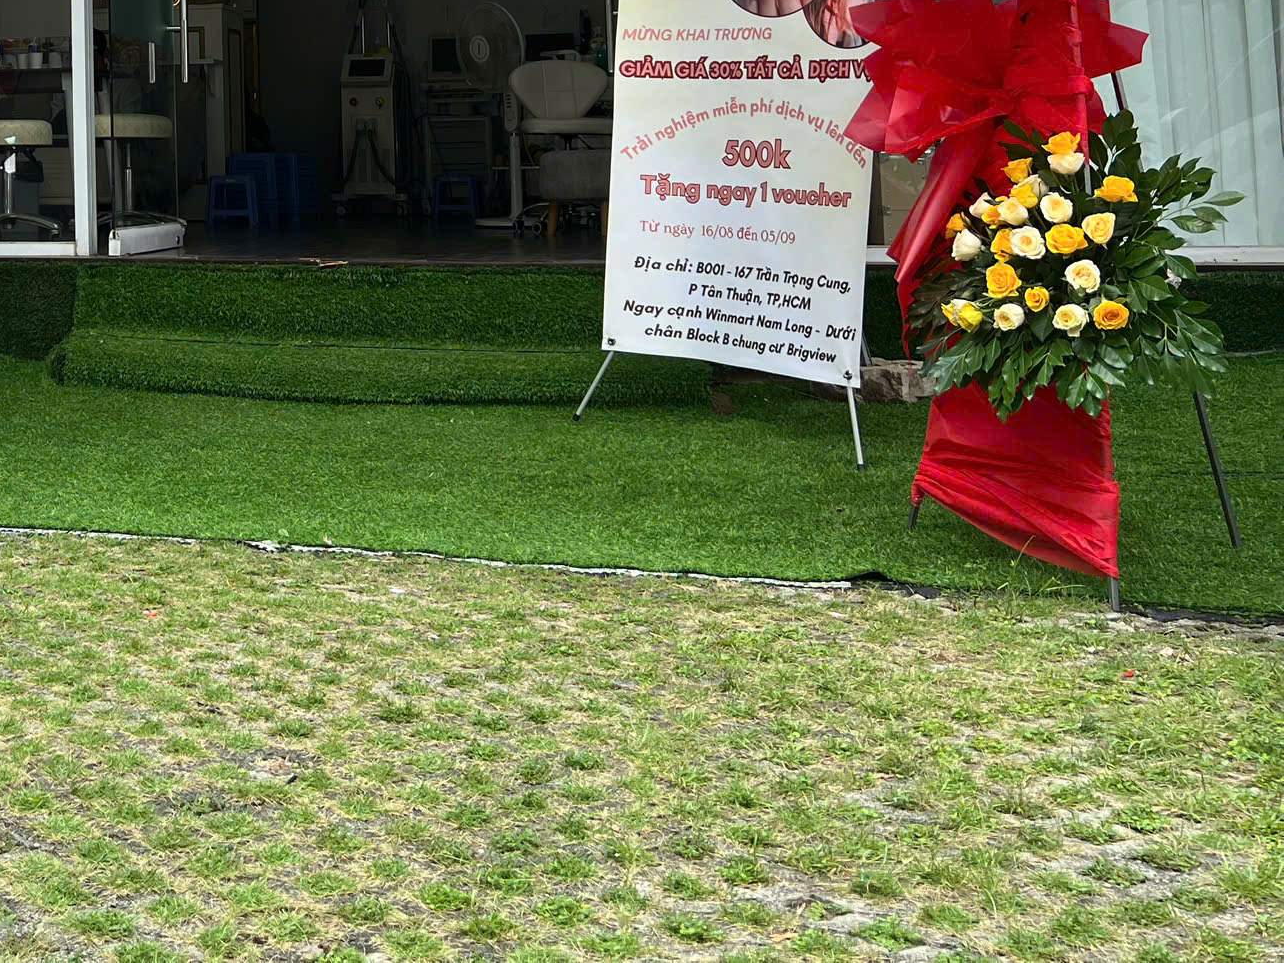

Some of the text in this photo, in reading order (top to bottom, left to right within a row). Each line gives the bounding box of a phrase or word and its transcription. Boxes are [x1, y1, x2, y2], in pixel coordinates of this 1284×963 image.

[676, 28, 711, 41] KHAI
[714, 27, 773, 41] TRƯƠNG
[674, 56, 710, 79] GIÁ
[709, 60, 743, 79] 30%
[777, 54, 804, 79] CẢ
[808, 59, 851, 83] DỊCH
[655, 110, 710, 141] nghiệm
[750, 97, 774, 117] phí
[775, 100, 805, 121] dịch
[807, 114, 825, 133] vụ
[825, 120, 845, 145] lên
[721, 138, 792, 169] 500k
[640, 173, 852, 208] Tặng ngay voucher
[664, 223, 695, 239] ngày
[701, 224, 734, 239] 16/08
[760, 230, 796, 245] 05/09
[634, 256, 661, 272] Địa
[696, 262, 725, 276] B001
[734, 266, 754, 279] 167
[756, 266, 780, 283] Trần
[783, 270, 814, 290] Trọng
[817, 275, 851, 294] Cung,
[701, 284, 723, 299] Tân
[726, 287, 762, 306] Thuận,
[623, 299, 857, 342] Ngay cạnh Winmart Nam Long Dưới
[644, 324, 837, 363] chân Block chung cư Brigview
